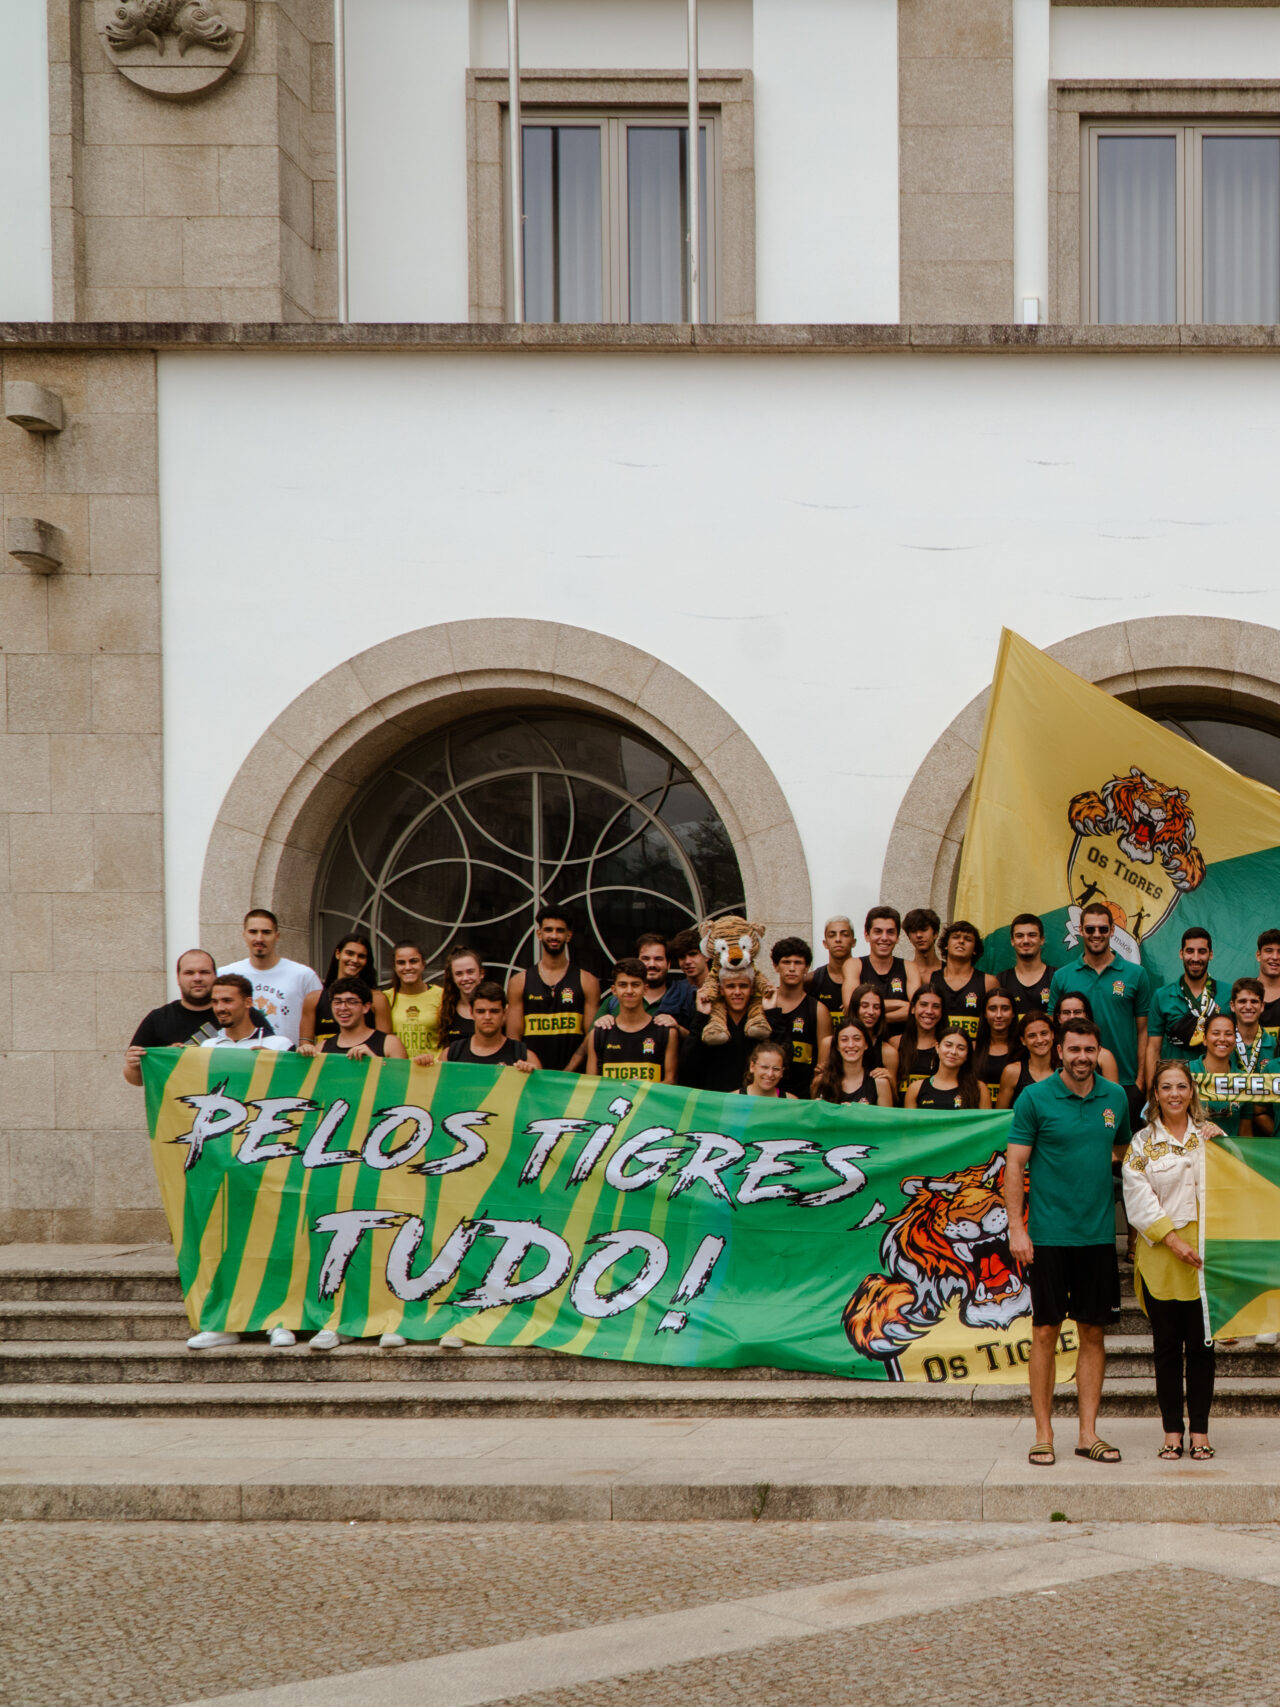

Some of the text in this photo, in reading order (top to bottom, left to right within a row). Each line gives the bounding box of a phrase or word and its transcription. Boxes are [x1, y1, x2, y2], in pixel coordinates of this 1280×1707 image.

[1114, 859, 1163, 900] TIGRES
[528, 1017, 576, 1031] TIGRES
[605, 1066, 655, 1080] TIGRES
[1215, 1077, 1270, 1095] E.F.E.
[166, 1077, 497, 1175] PELOS
[309, 1210, 727, 1335] TUDO!
